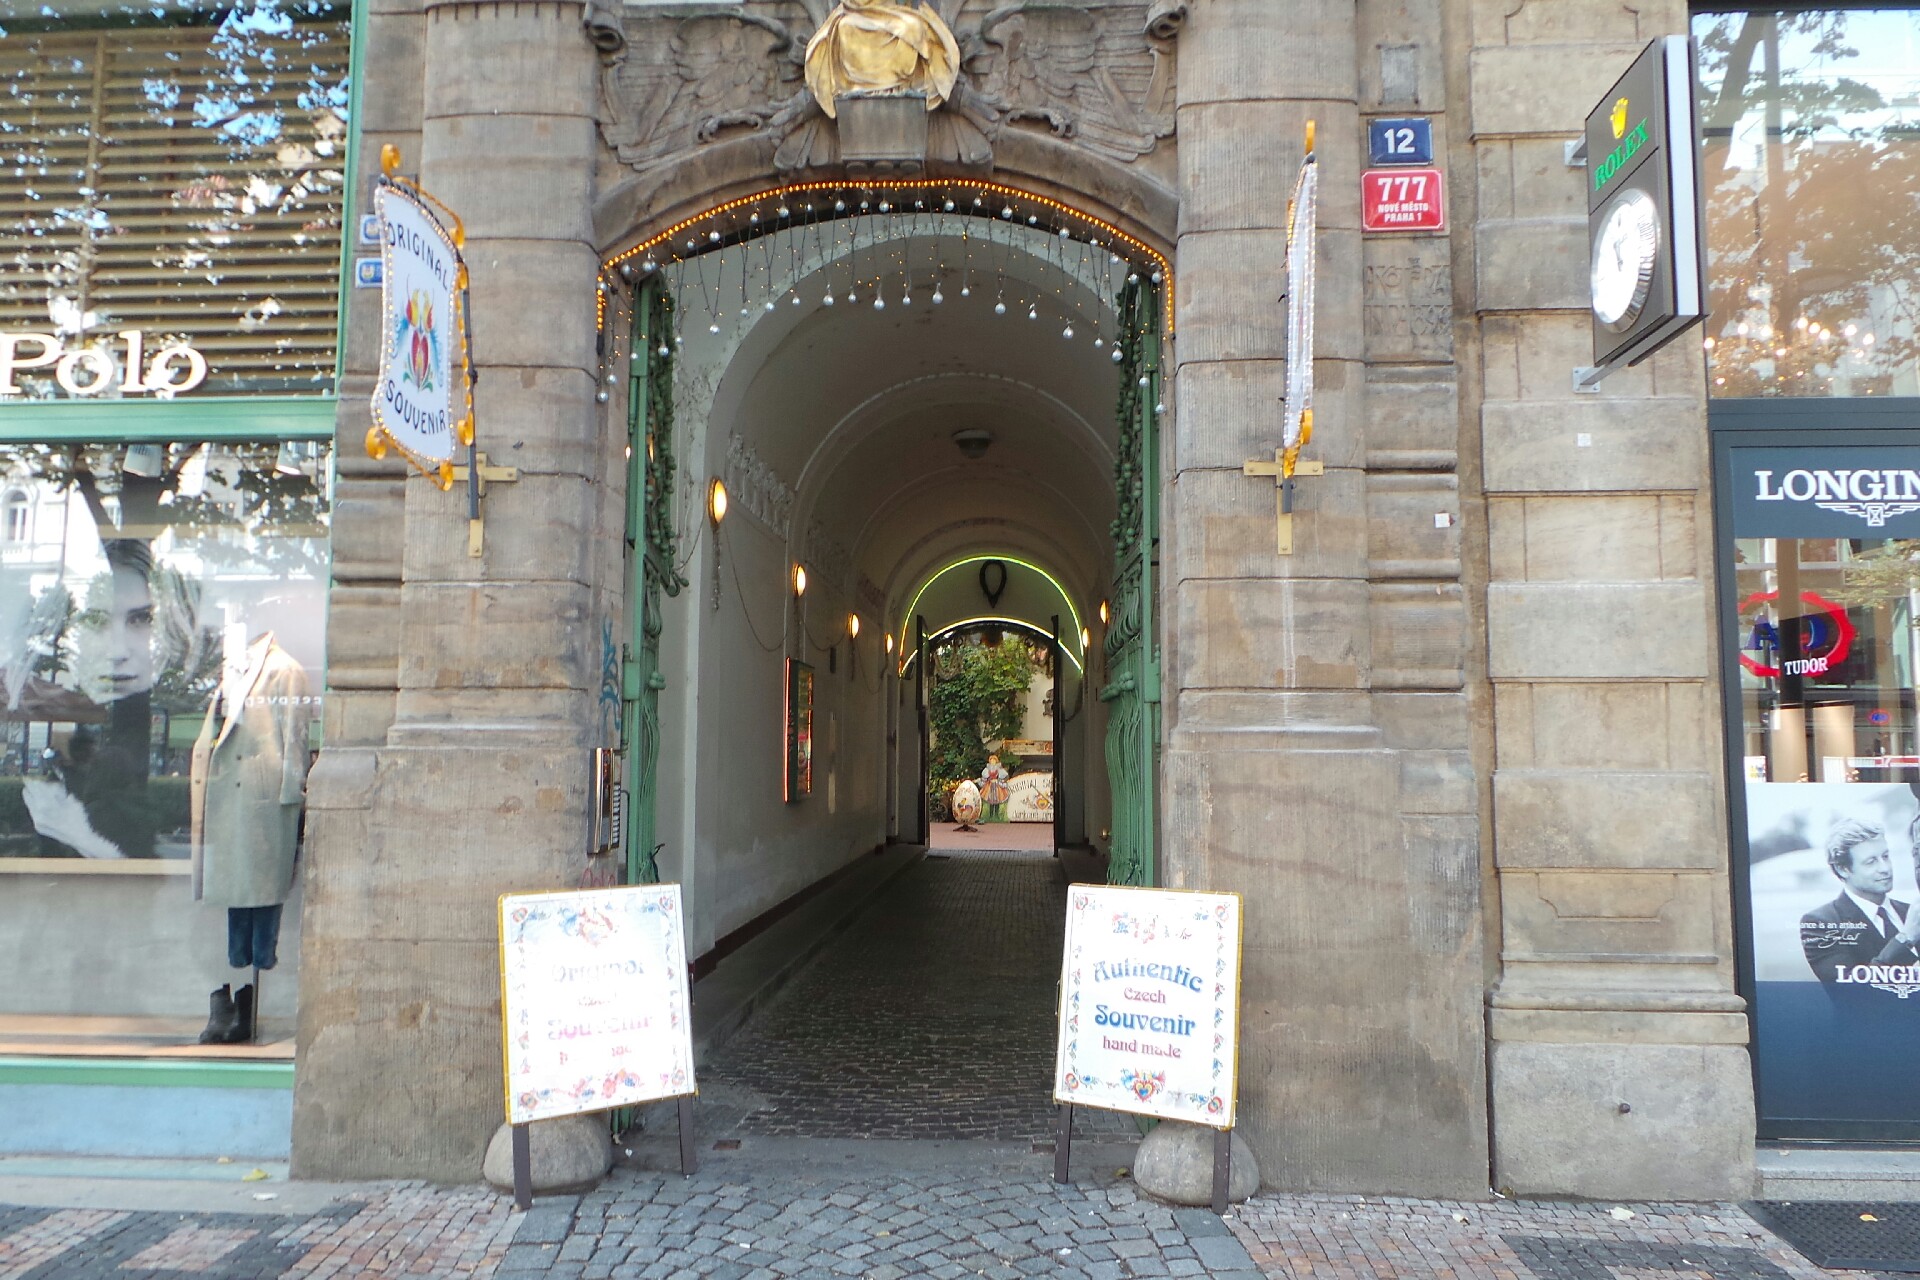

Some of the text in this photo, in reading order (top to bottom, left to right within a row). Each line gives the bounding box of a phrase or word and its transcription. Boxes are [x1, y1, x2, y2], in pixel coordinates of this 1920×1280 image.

[1384, 128, 1415, 153] 12
[1594, 117, 1648, 191] ROLEX
[1378, 176, 1426, 202] 777
[1378, 202, 1400, 213] NOVÉ
[1384, 212, 1422, 222] PRAHA 1
[386, 222, 448, 290] ORIGINAL
[0, 330, 208, 394] Polo
[386, 379, 446, 434] SOUVENIR
[1784, 657, 1829, 676] TUDOR
[1835, 965, 1920, 984] LONGI
[1094, 1004, 1196, 1036] Souvenir
[1103, 1035, 1181, 1059] hand made
